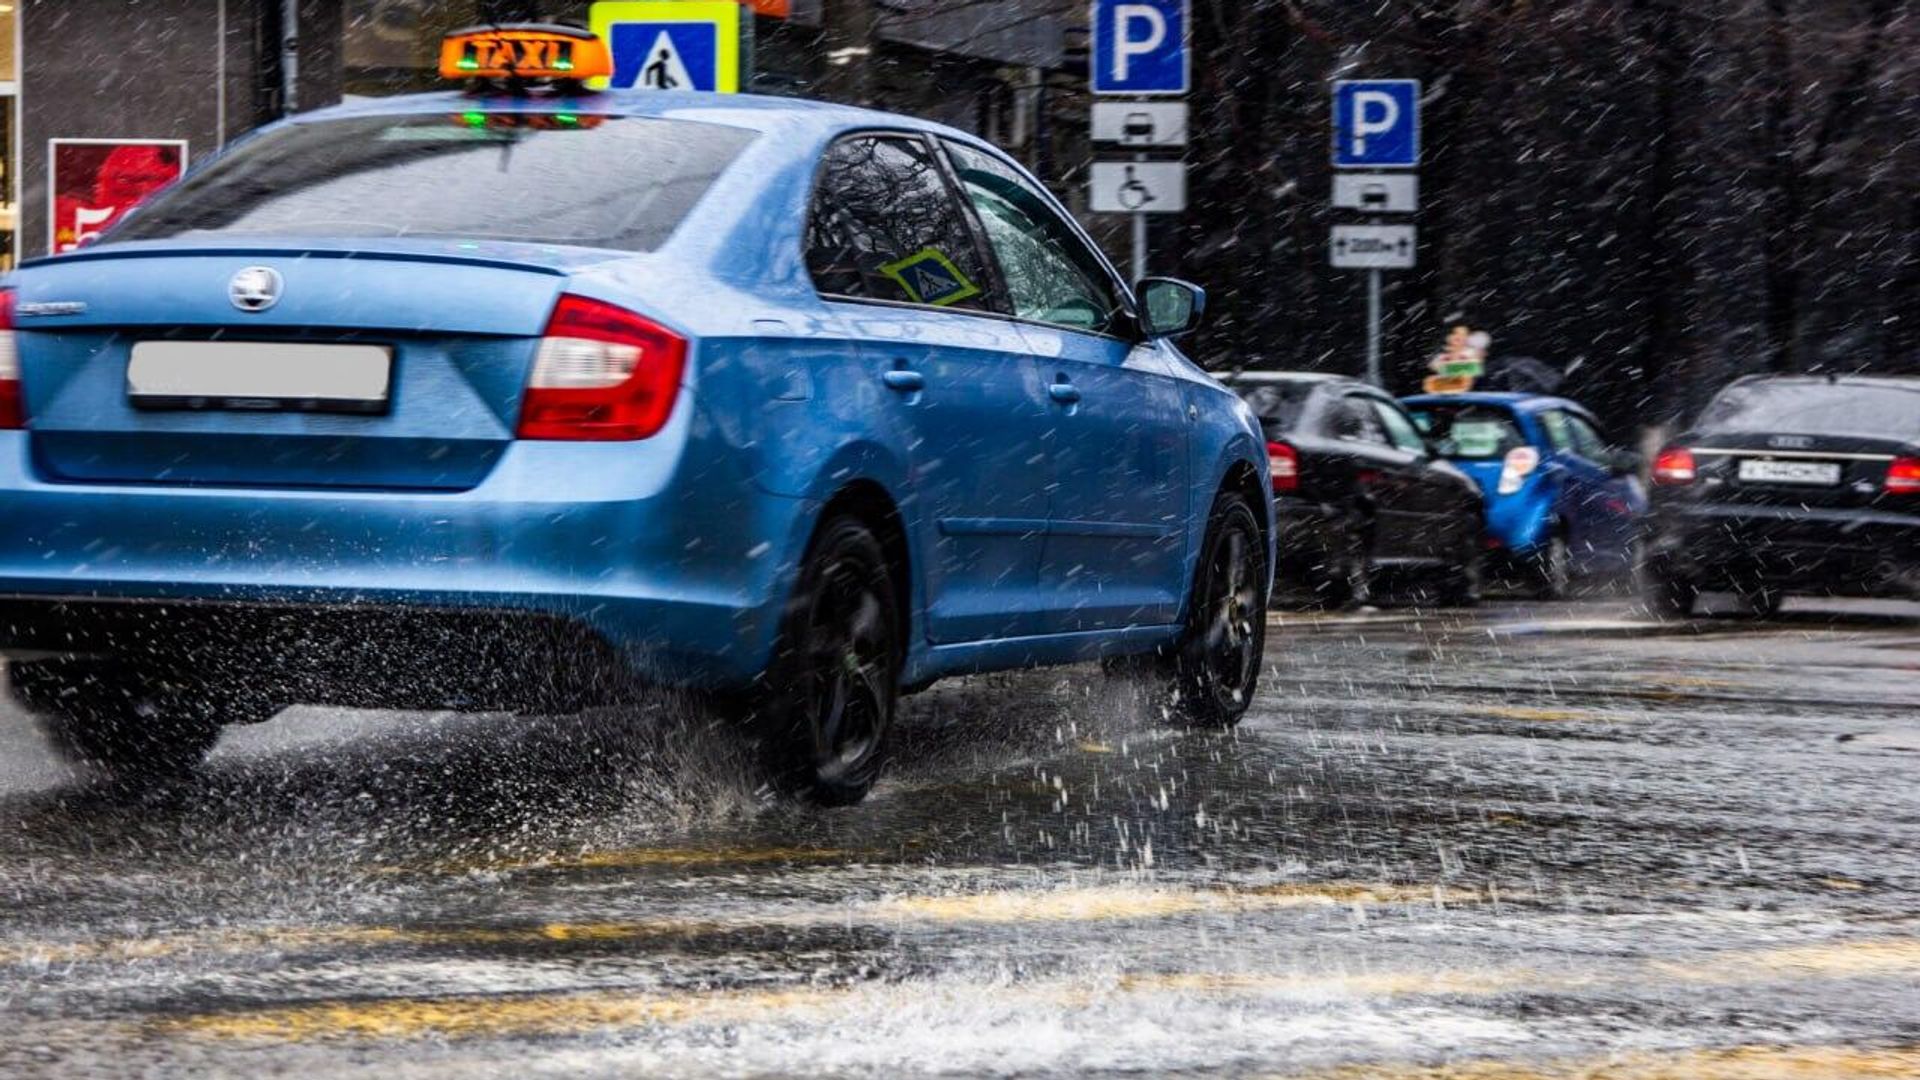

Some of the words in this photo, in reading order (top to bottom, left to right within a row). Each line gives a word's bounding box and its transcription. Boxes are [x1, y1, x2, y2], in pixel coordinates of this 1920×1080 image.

[467, 40, 562, 69] TAXI
[1113, 4, 1167, 81] P
[1352, 90, 1399, 156] P
